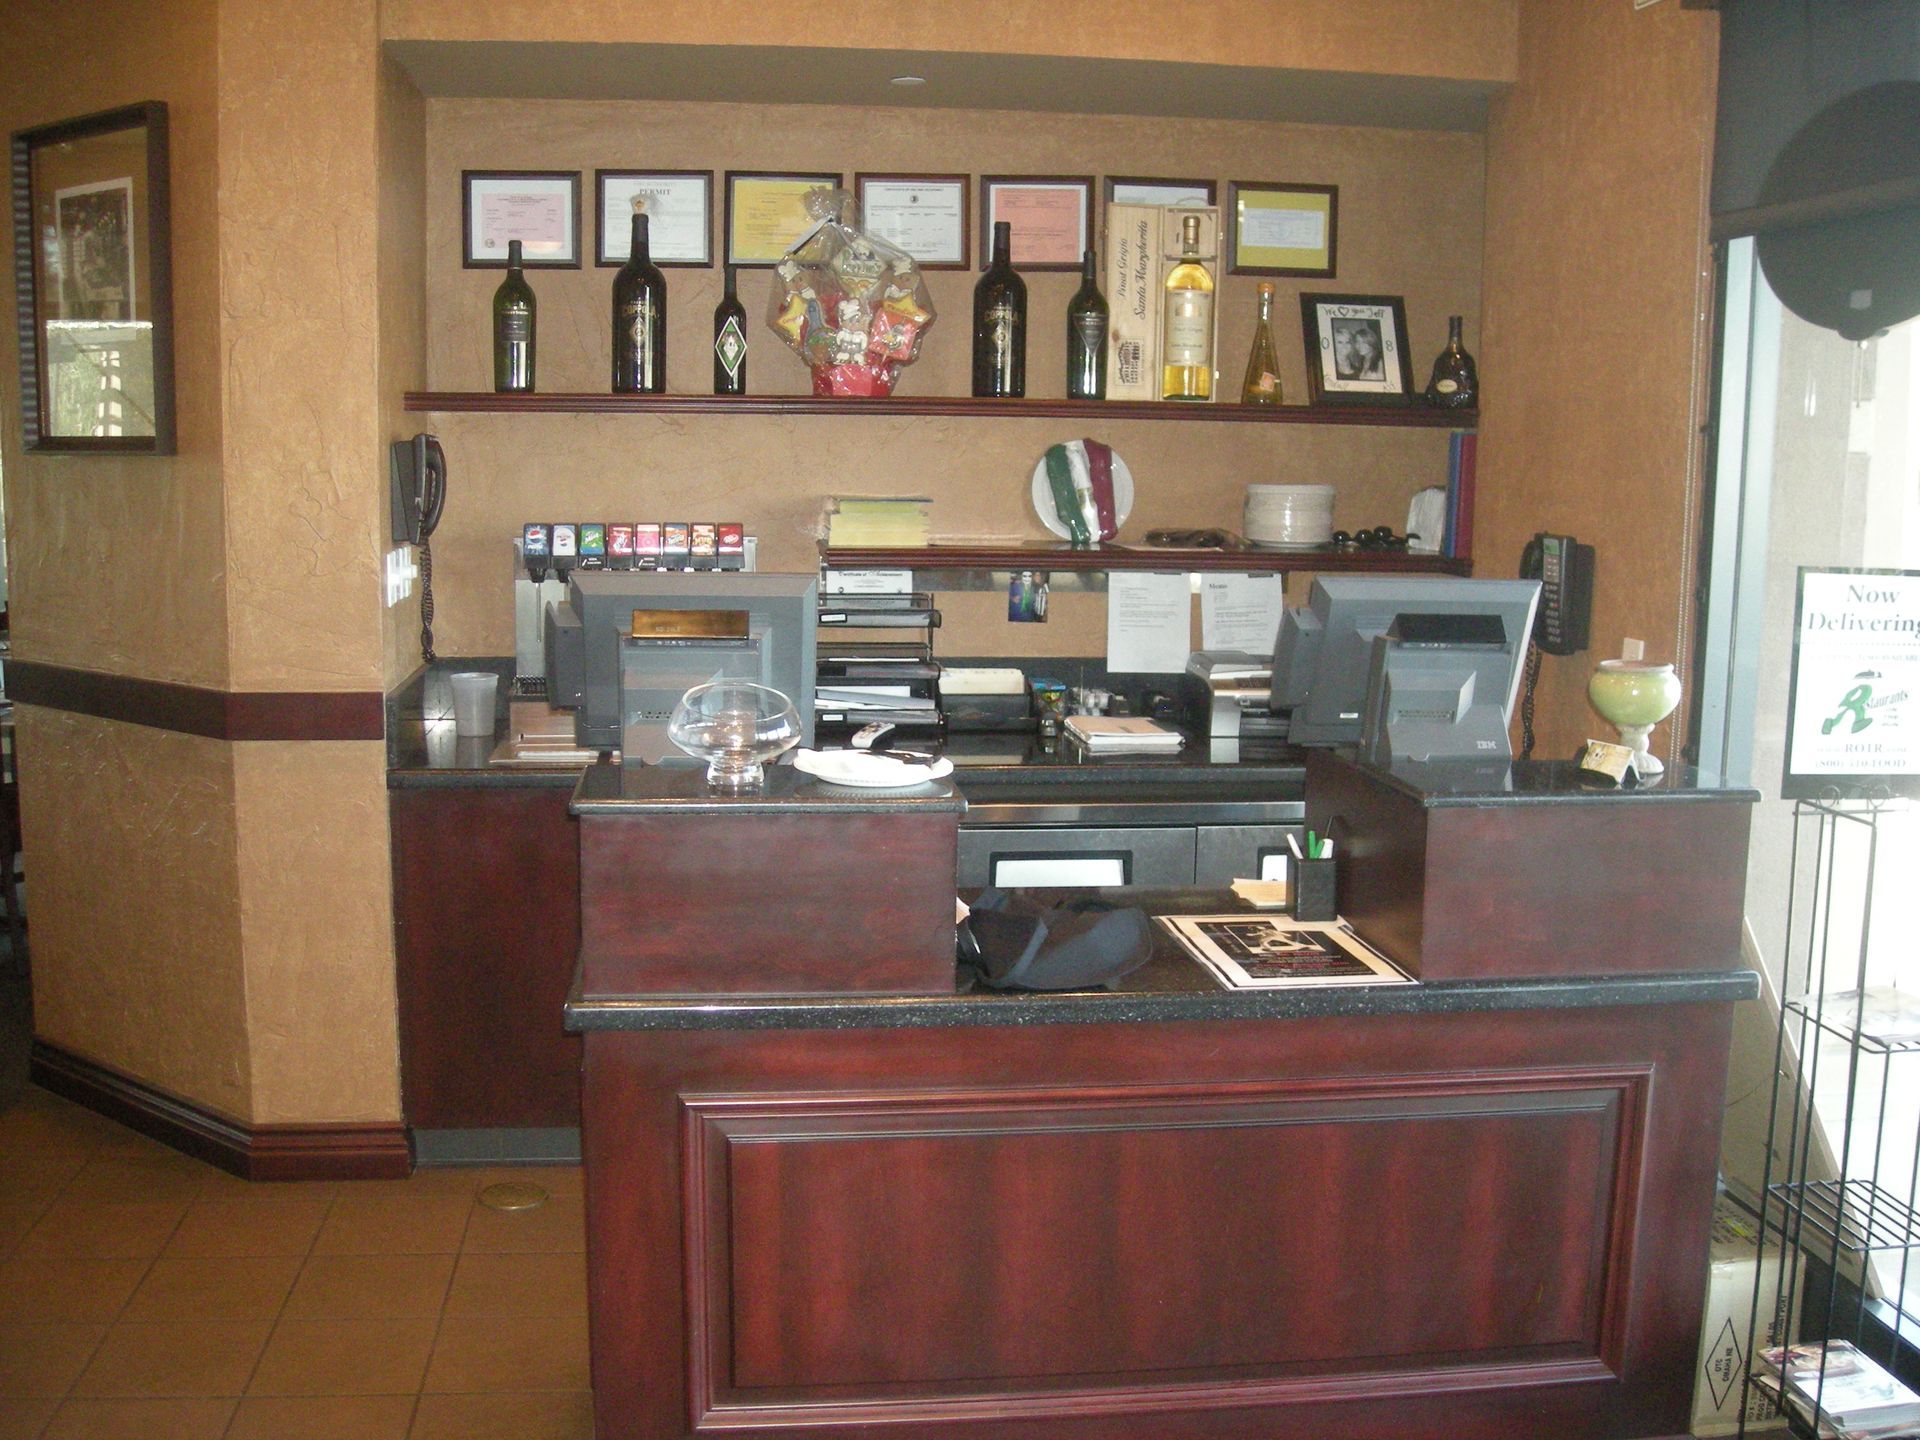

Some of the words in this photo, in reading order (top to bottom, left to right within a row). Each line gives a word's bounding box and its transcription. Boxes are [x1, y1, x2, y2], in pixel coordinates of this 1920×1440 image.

[639, 188, 672, 196] PERMIT
[1117, 238, 1129, 271] Grigio
[1134, 219, 1150, 286] Margherita
[1116, 271, 1127, 298] Pinot
[1133, 286, 1147, 320] Santa
[1846, 584, 1902, 604] Now
[1807, 611, 1920, 640] Delivering
[1476, 740, 1497, 749] IBM
[1726, 1347, 1734, 1357] NE
[1722, 1359, 1733, 1382] OMAHA
